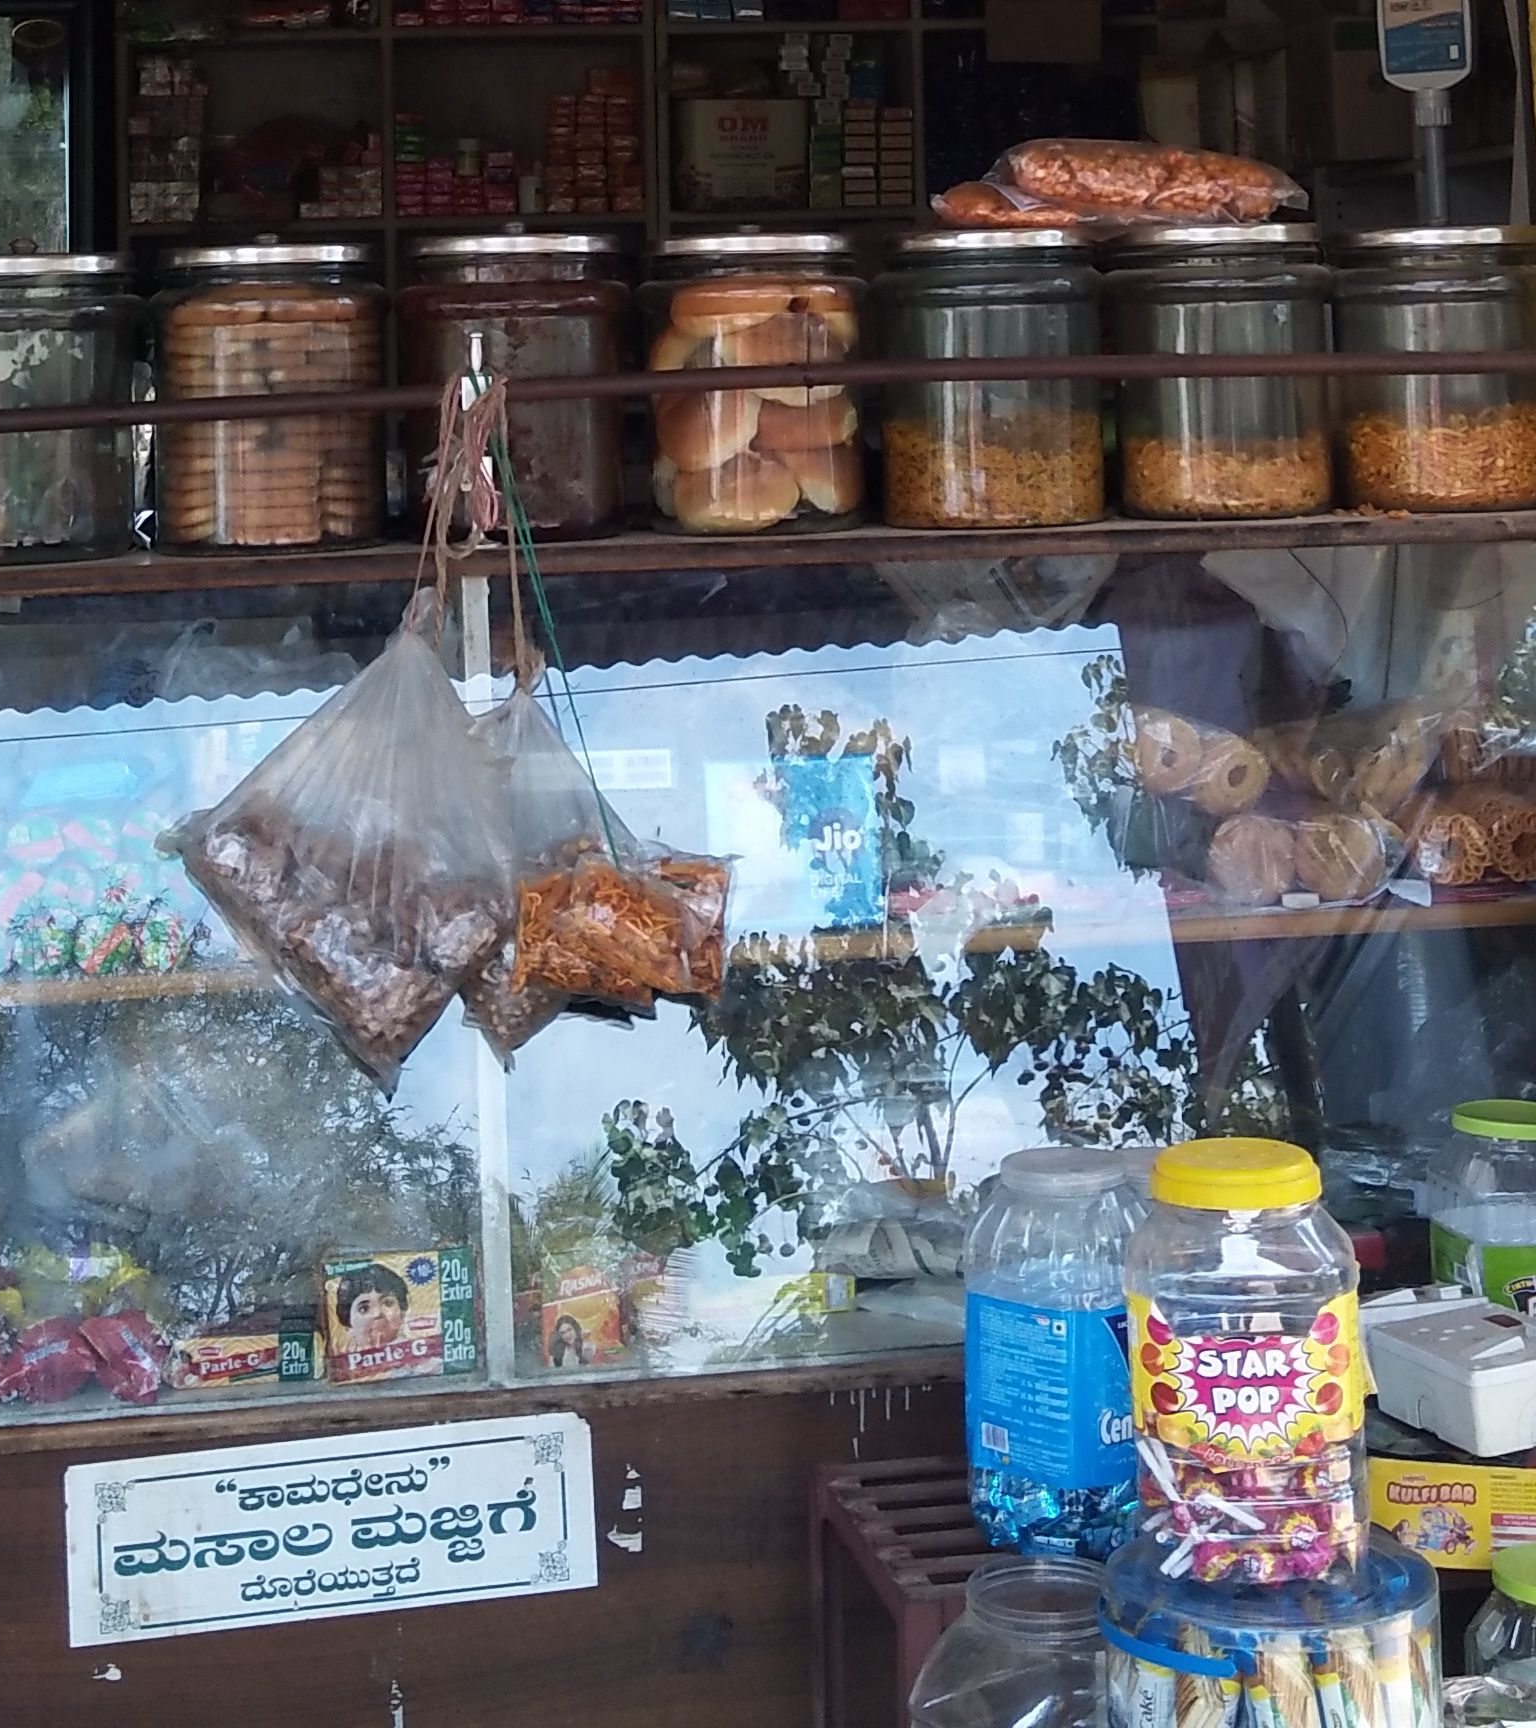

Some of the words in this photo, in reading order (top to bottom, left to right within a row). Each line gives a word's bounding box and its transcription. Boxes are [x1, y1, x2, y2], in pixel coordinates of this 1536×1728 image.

[815, 822, 862, 851] Jio
[440, 1258, 469, 1283] 20g
[440, 1284, 473, 1302] Extra
[443, 1319, 471, 1344] 20g
[282, 1341, 307, 1362] 20g
[348, 1339, 428, 1370] Parle-G
[443, 1343, 476, 1362] Extra
[1196, 1349, 1292, 1379] STAR
[200, 1354, 260, 1375] Parle-G
[281, 1361, 309, 1376] Extra
[1212, 1385, 1281, 1415] POP
[1388, 1483, 1437, 1504] KULFI
[1439, 1483, 1477, 1504] BAR
[113, 1518, 334, 1579] ಮಸಾಲ
[350, 1487, 538, 1564] ಮಜ್ಜಿಗೆ
[239, 1556, 422, 1603] ದೊರೆಯುತ್ತದೆ
